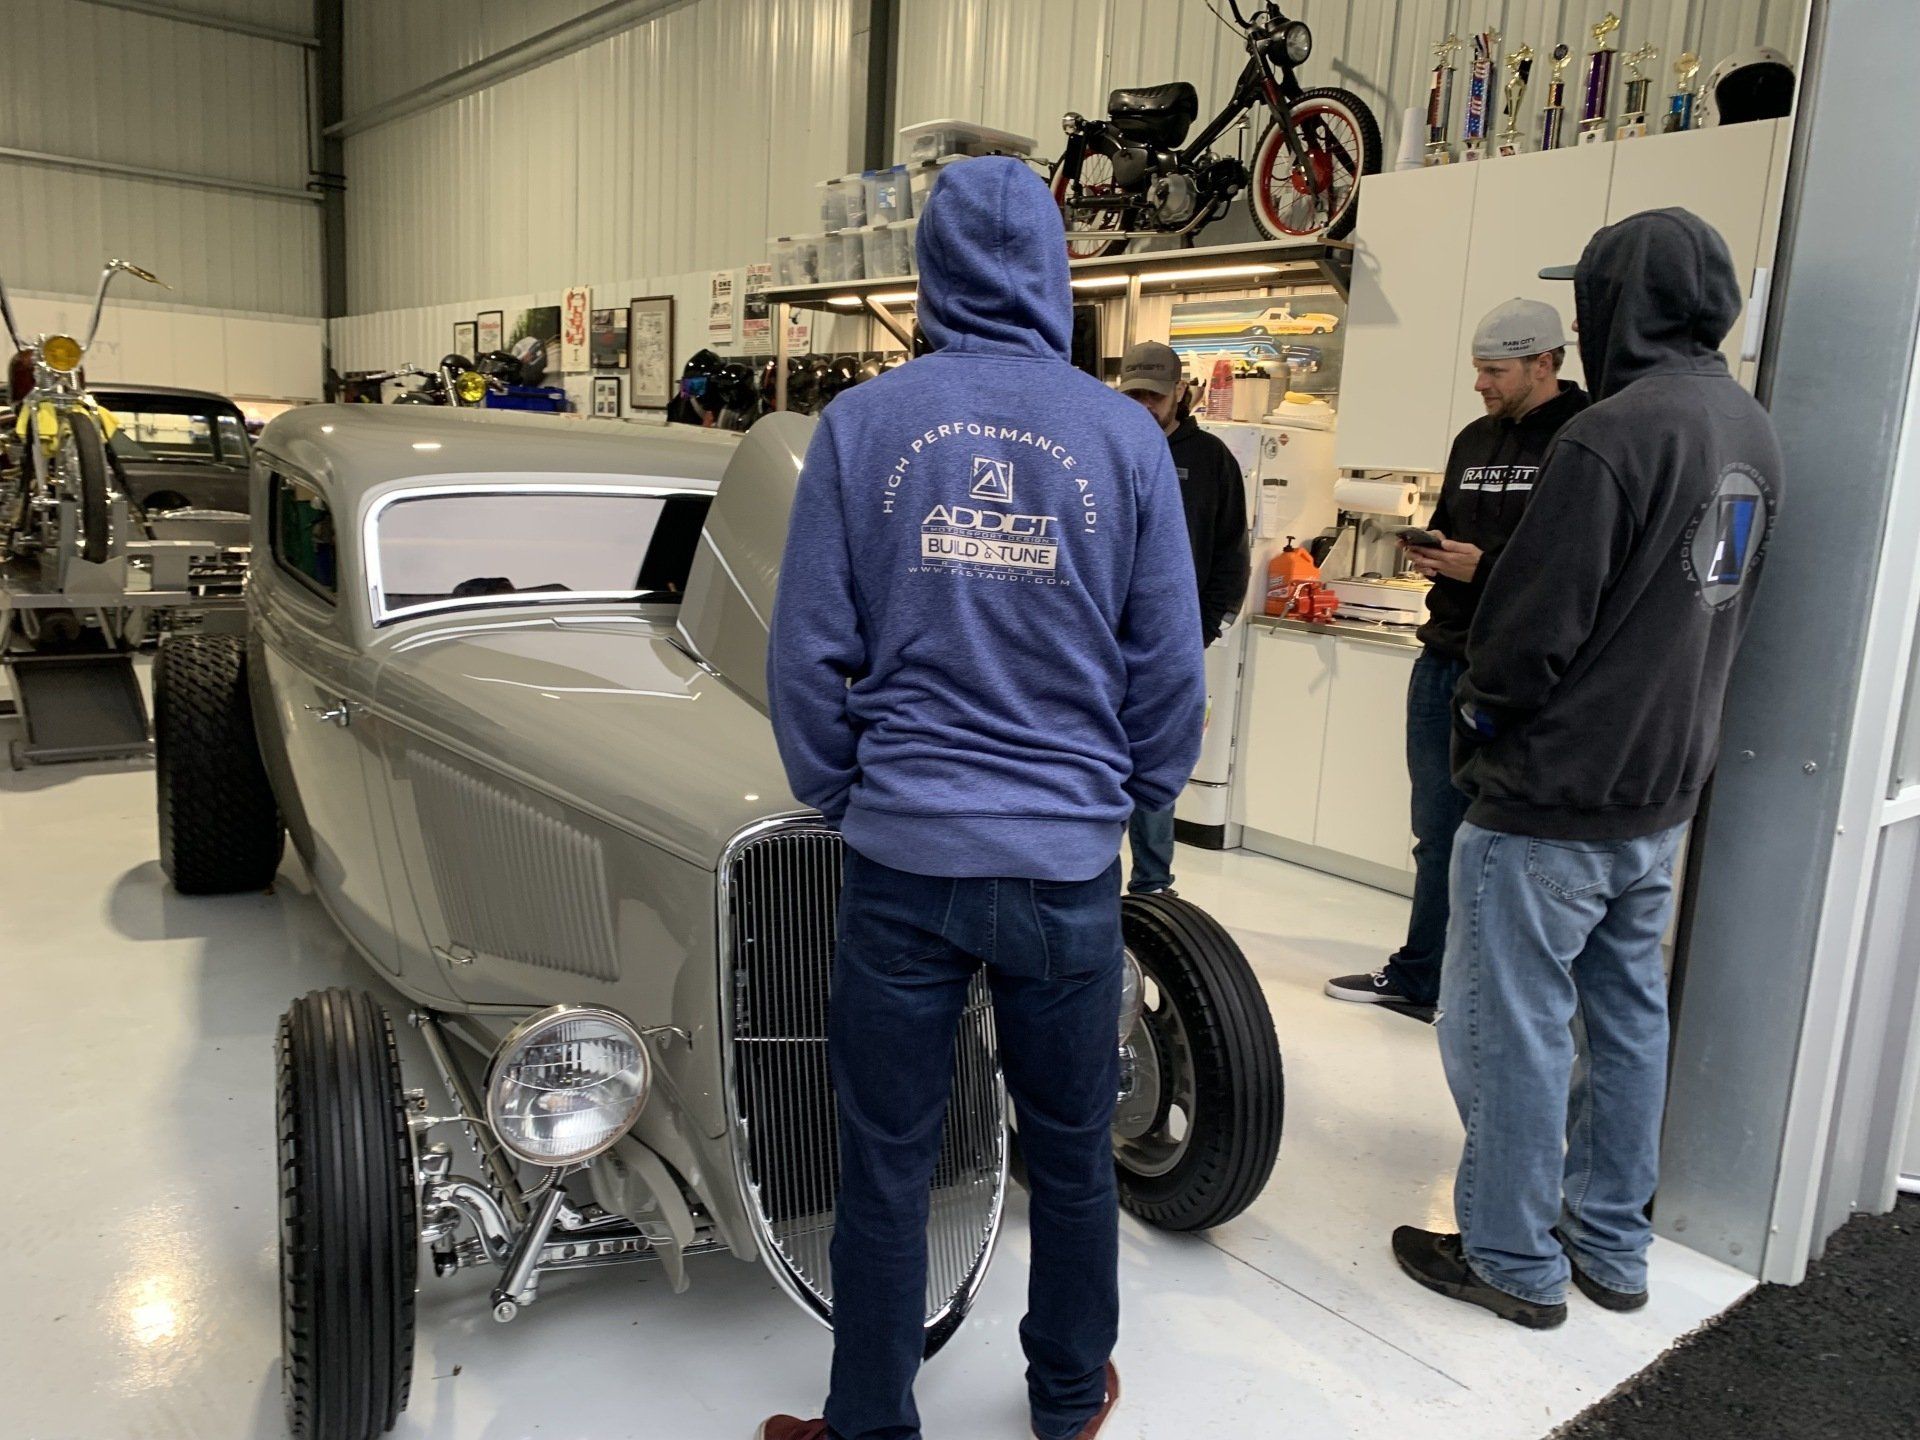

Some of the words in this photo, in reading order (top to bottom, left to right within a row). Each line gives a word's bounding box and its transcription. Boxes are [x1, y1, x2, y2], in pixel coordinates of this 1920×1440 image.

[883, 456, 910, 514] HIGH
[911, 422, 1078, 470] PERFORMANCE
[1075, 477, 1097, 534] AUDI
[1464, 470, 1501, 481] RAIN
[1503, 469, 1539, 480] CIT
[922, 504, 1058, 537] ADDICT
[930, 526, 1003, 541] MOTORSPORT
[928, 538, 979, 558] BUILD
[984, 548, 992, 559] &
[998, 545, 1051, 565] TUNE
